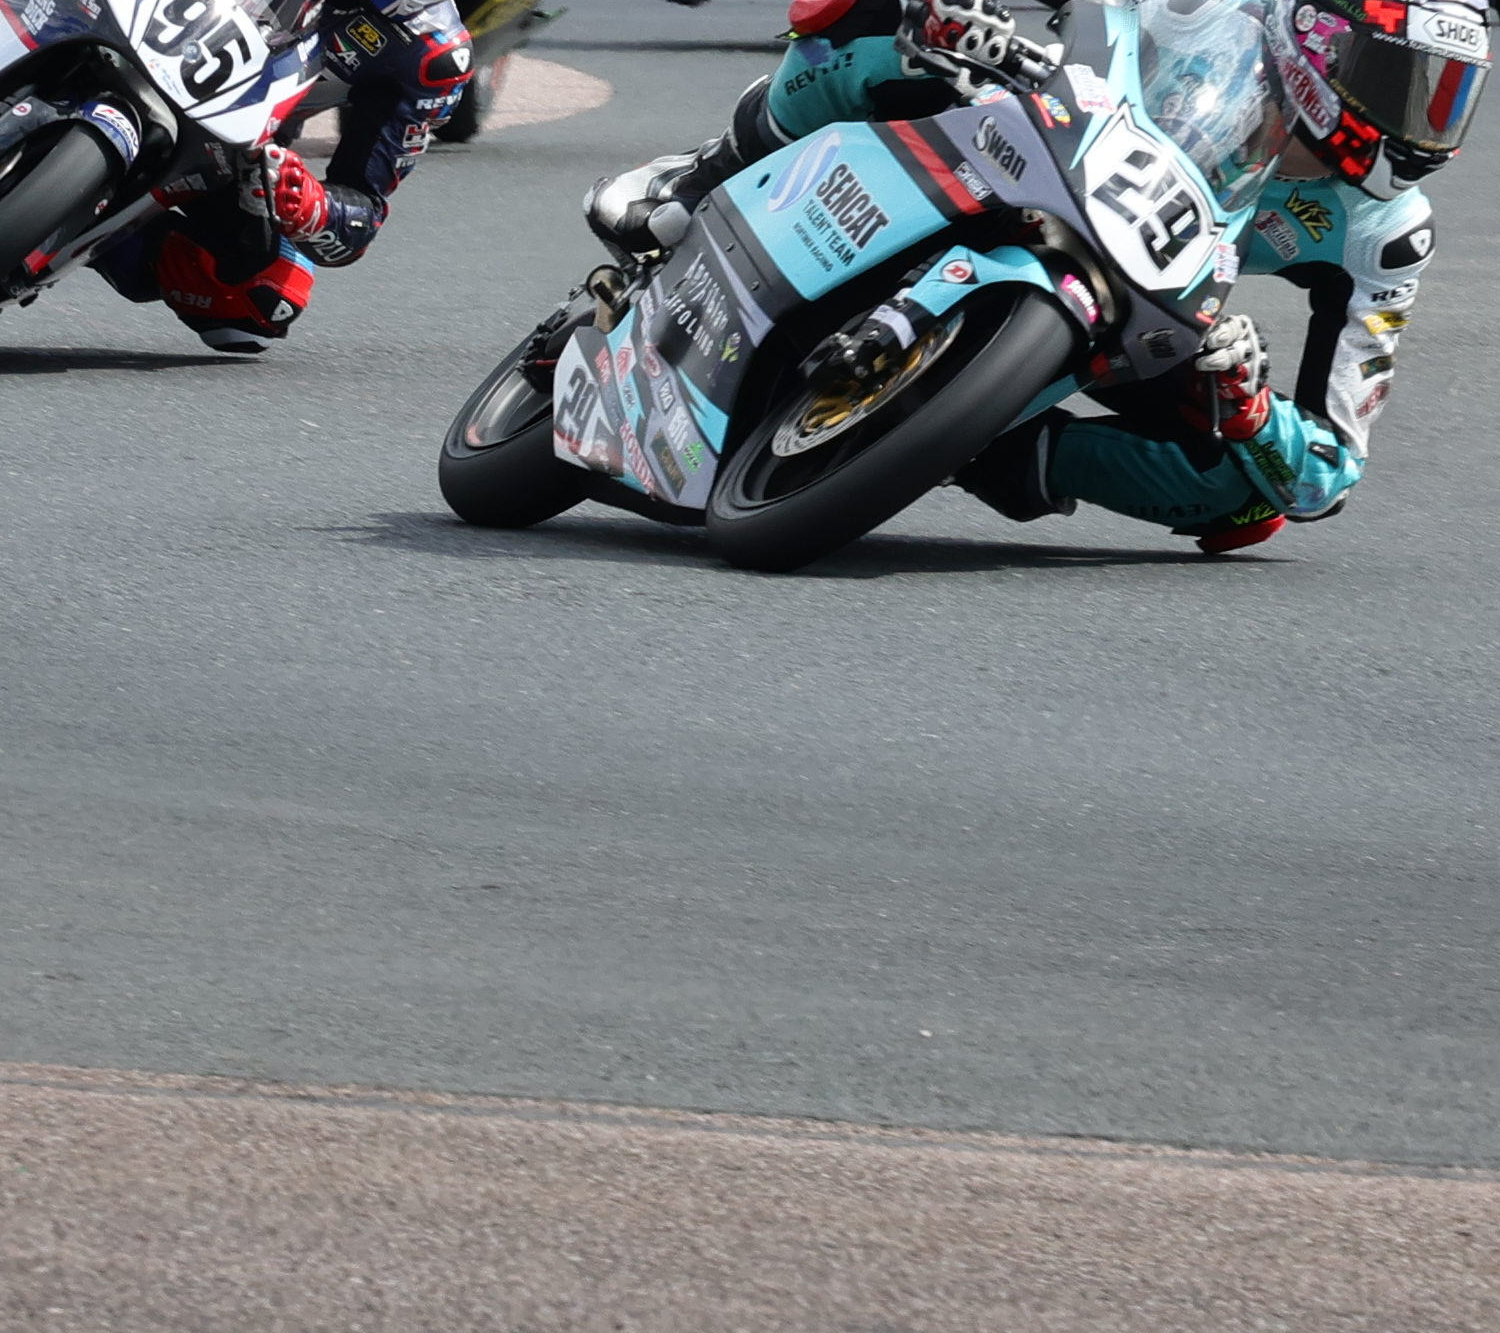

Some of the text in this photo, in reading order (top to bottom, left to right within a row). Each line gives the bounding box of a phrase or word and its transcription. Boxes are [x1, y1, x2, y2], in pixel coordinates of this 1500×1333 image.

[972, 115, 1026, 182] Swan
[801, 199, 833, 236] TALENT
[825, 230, 857, 267] TEAM
[815, 162, 890, 251] SENCAT
[1089, 149, 1202, 271] 29
